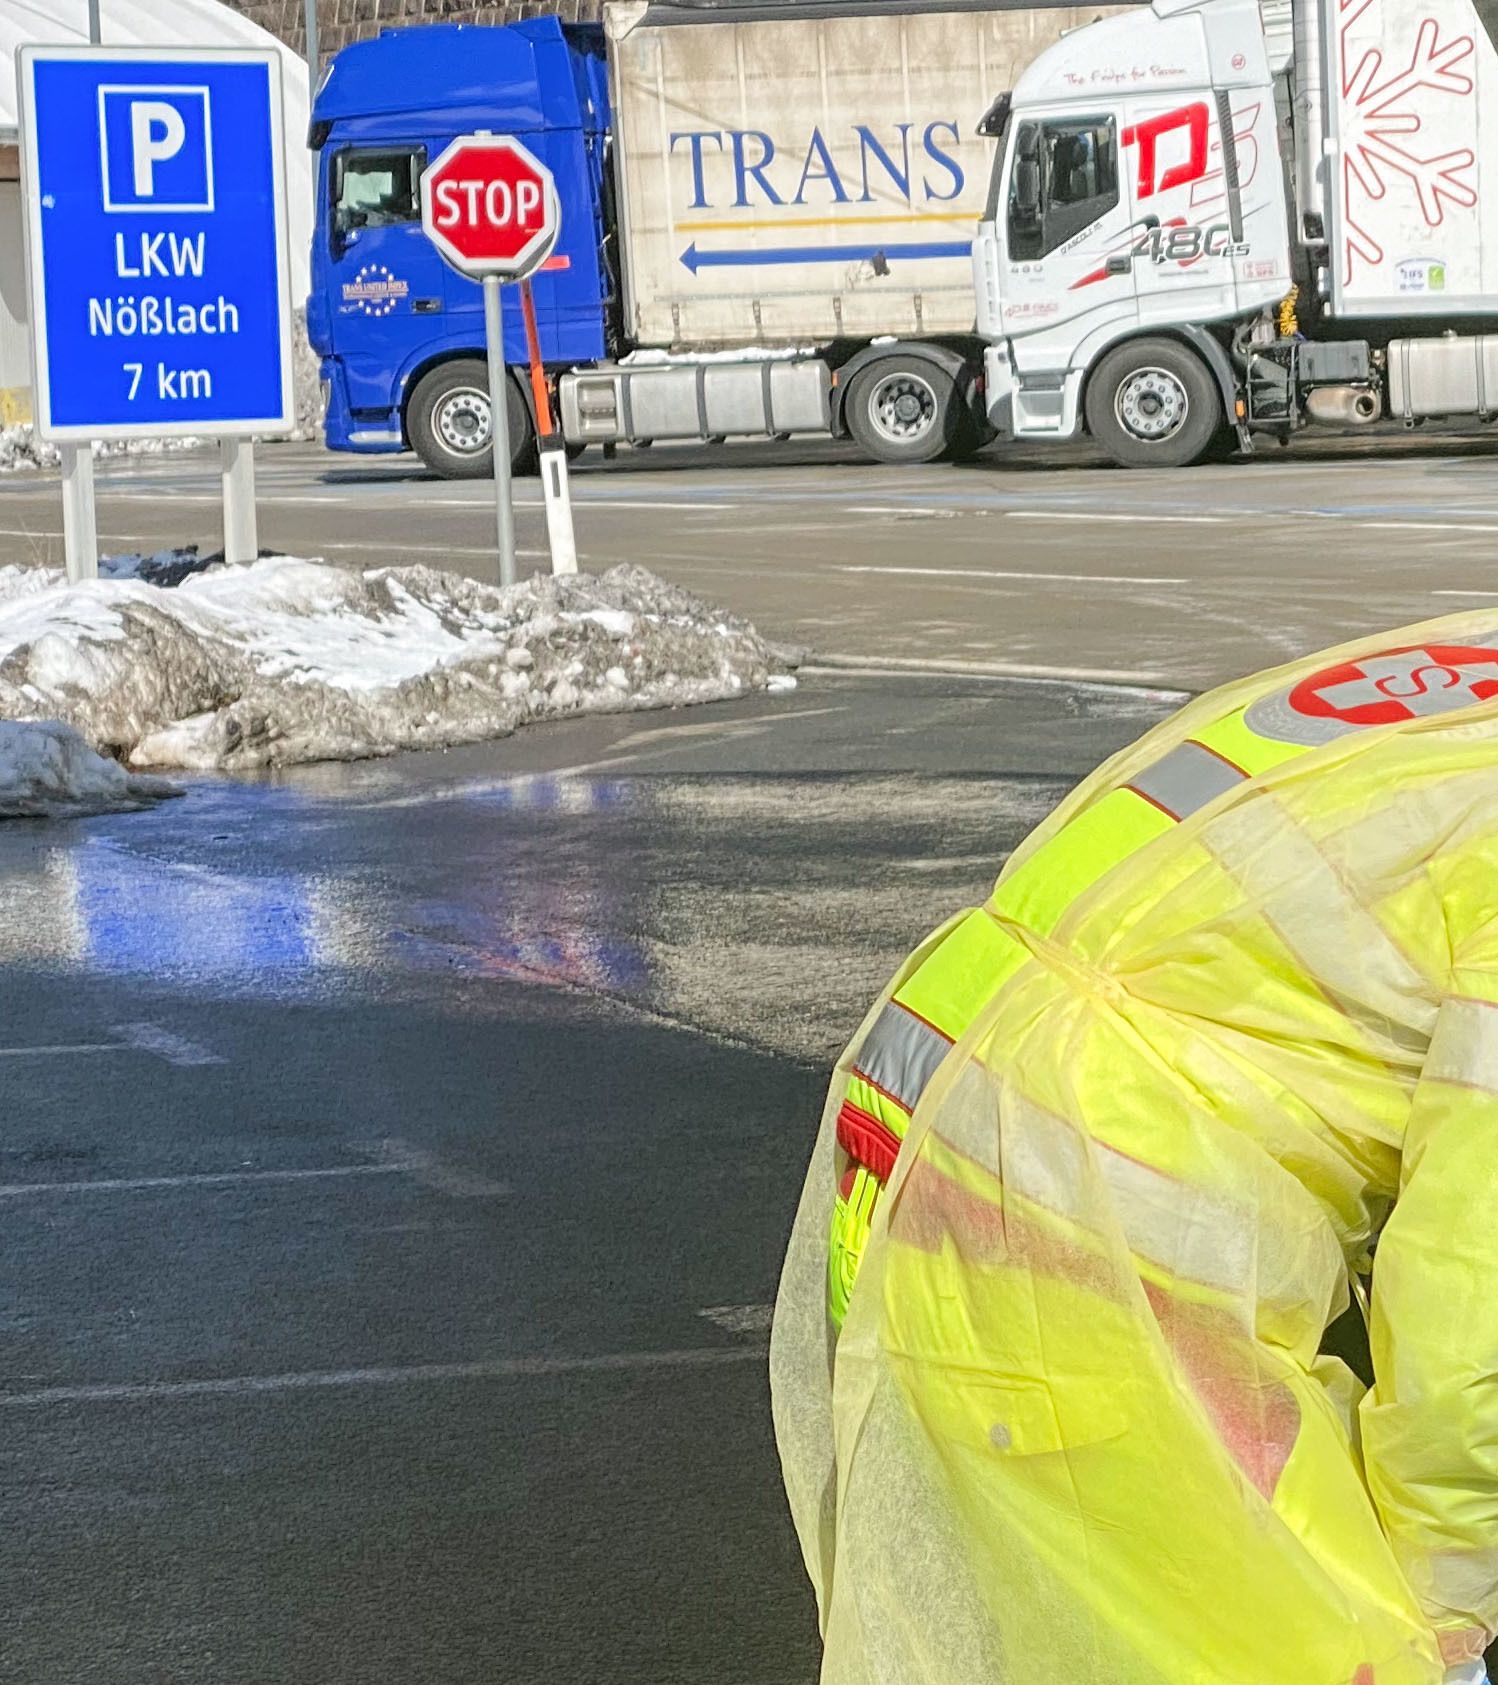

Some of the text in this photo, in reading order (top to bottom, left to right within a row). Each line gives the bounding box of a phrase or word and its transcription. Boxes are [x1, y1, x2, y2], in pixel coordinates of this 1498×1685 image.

[131, 101, 186, 196] P
[670, 120, 964, 208] TRANS
[436, 180, 540, 226] STOP
[116, 232, 205, 277] LKW
[89, 296, 239, 336] Nößlach
[123, 362, 211, 400] 7 km
